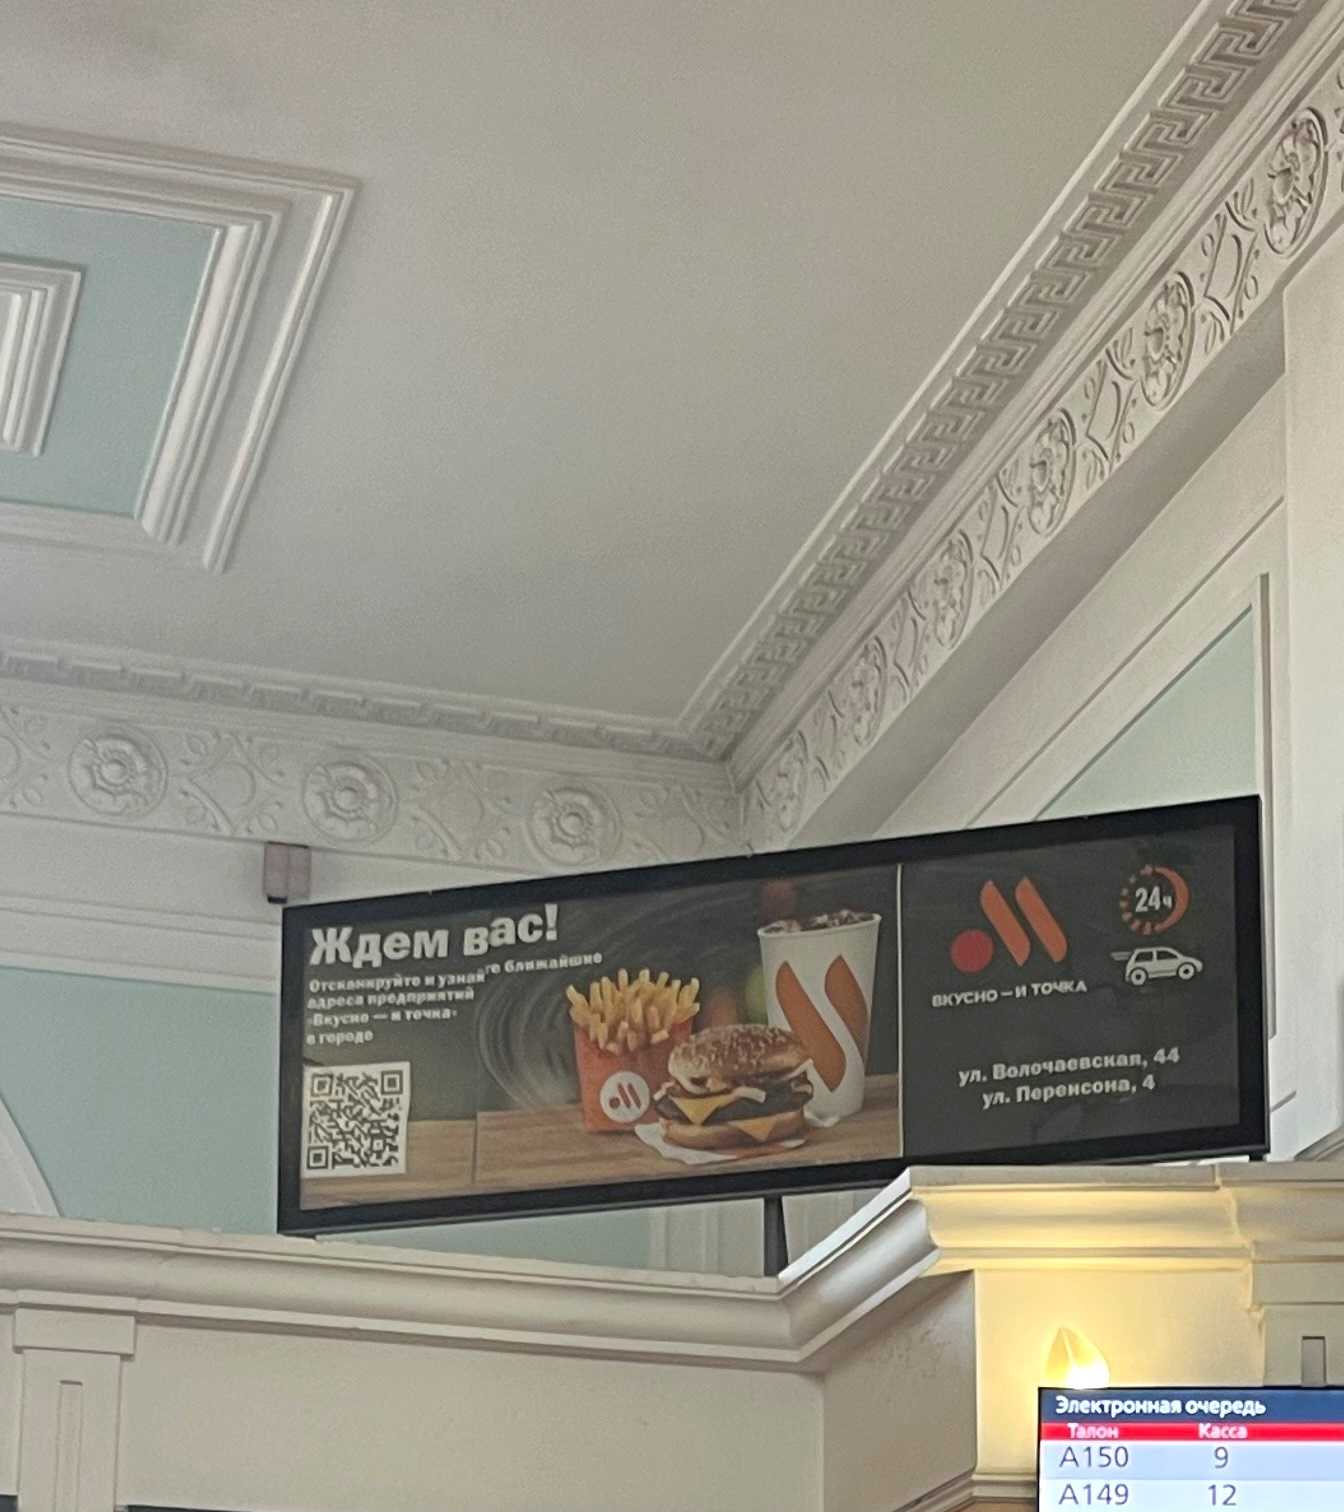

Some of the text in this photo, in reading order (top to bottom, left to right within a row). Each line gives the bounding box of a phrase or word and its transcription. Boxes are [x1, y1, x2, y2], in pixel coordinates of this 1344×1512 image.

[310, 904, 558, 968] Ждем вас!
[932, 990, 998, 1008] ВКУСНО
[1015, 985, 1027, 997] И
[1031, 980, 1087, 997] ТОЧКА
[958, 1068, 988, 1087] ул.
[1153, 1047, 1180, 1064] 44
[982, 1090, 1010, 1110] ул.
[1142, 1073, 1156, 1090] 4
[1056, 1395, 1266, 1417] Электронная очередь
[1067, 1423, 1119, 1438] Талон
[1199, 1423, 1247, 1439] Касса
[1214, 1446, 1229, 1469] 9
[1207, 1484, 1237, 1506] 12
